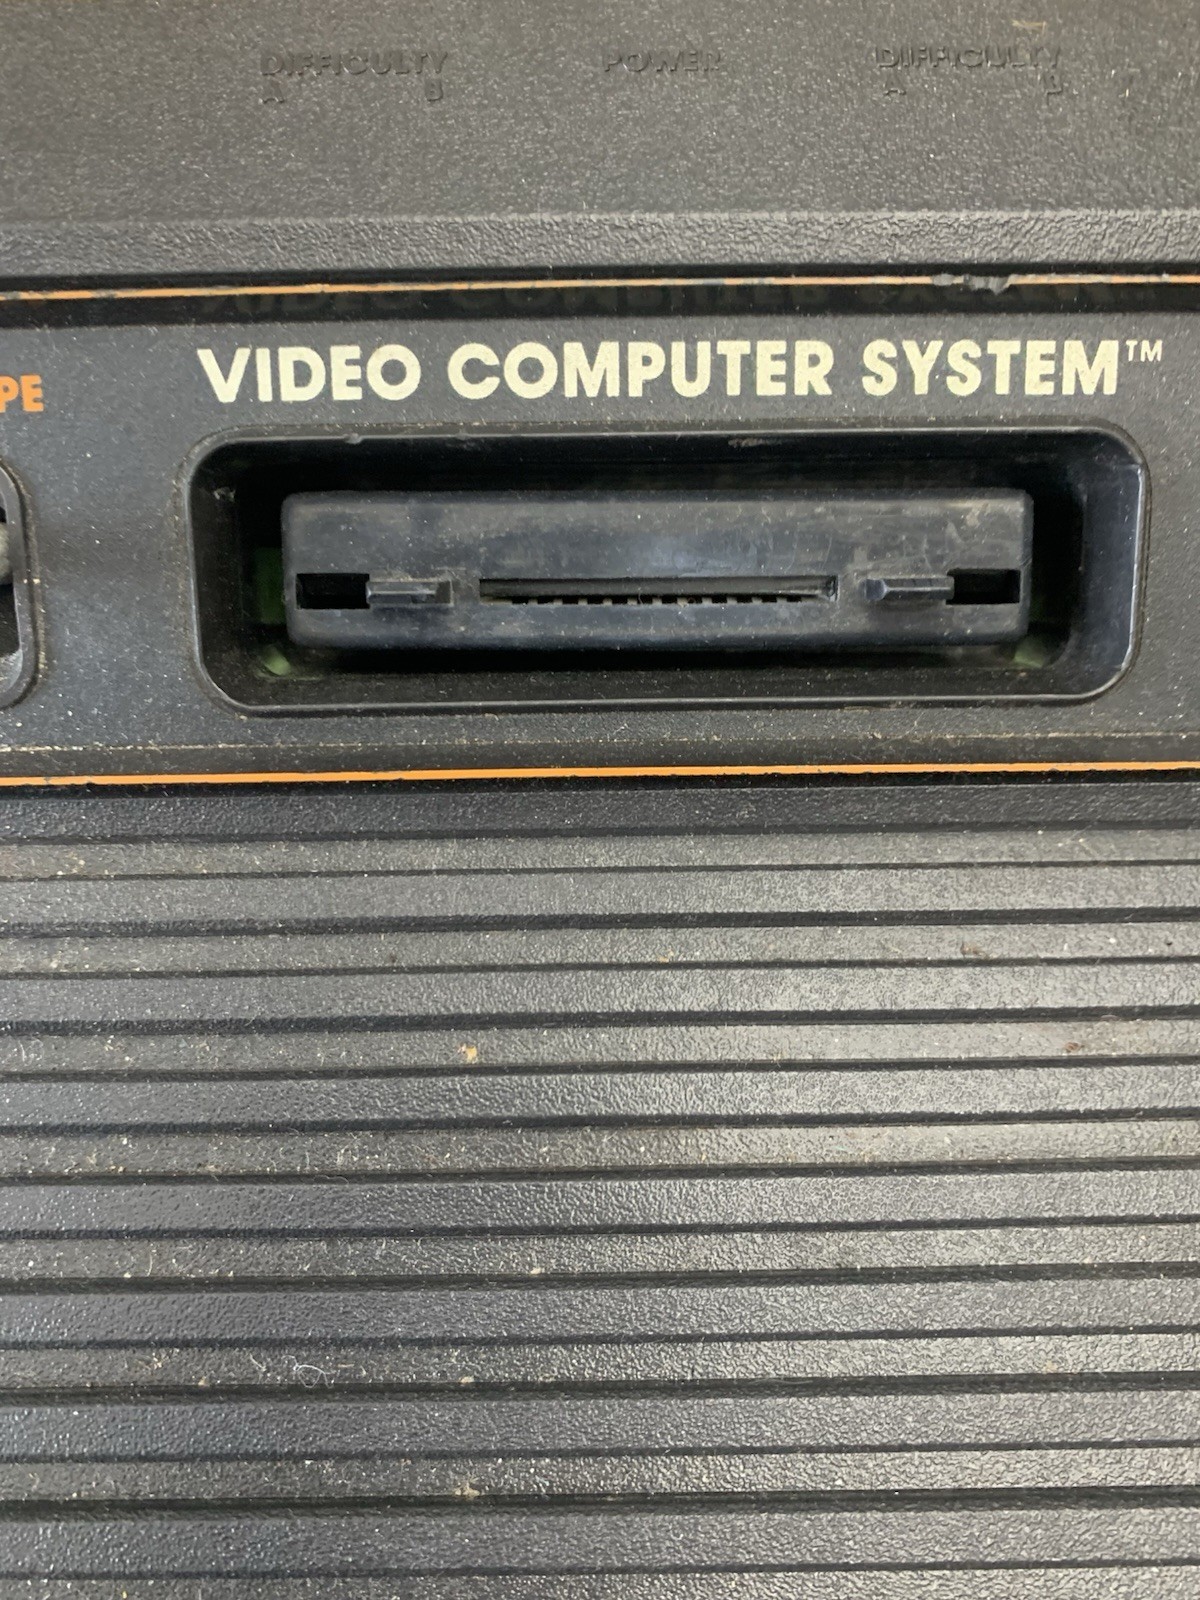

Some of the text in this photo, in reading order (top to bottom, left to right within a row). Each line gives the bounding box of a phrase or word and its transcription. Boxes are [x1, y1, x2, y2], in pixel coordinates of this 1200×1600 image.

[603, 49, 721, 73] POWER
[197, 342, 421, 402] VIDEO
[447, 339, 834, 399] COMPUTER
